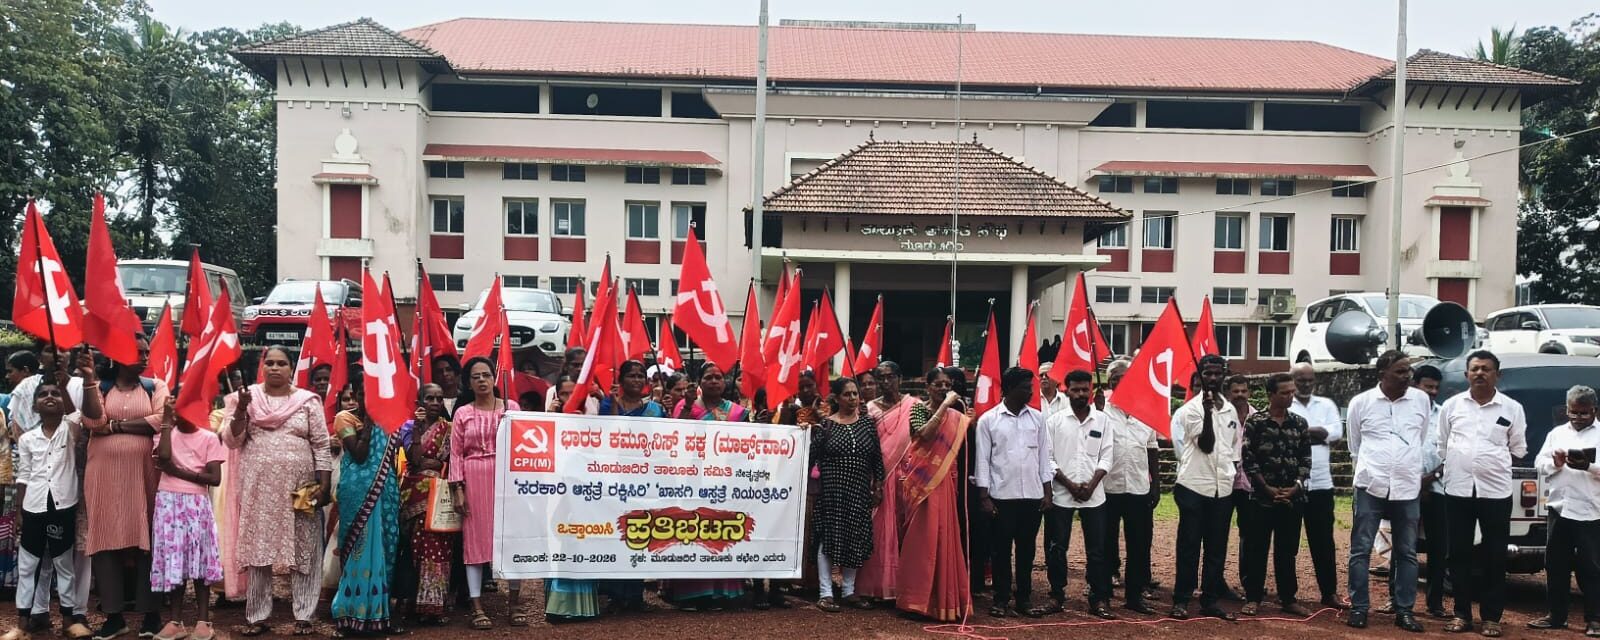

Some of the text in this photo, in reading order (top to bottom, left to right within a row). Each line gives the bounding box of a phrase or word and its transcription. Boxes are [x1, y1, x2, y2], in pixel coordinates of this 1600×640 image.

[561, 426, 603, 450] ಭಾರತ
[610, 427, 679, 458] ಕಮ್ಯೂನಿಸ್ಟ್
[685, 432, 707, 460] ಪಕ್ಷ
[514, 458, 551, 470] CPI(M)
[587, 460, 649, 474] ಮೂಡುಬಿದಿರೆ
[653, 464, 698, 477] ತಾಲೂಕು
[703, 465, 733, 478] ಸಮಿತಿ
[572, 481, 603, 502] ಆಸ್ಪತ್ರೆ
[698, 485, 727, 504] ಆಸ್ಪತ್ರೆ
[556, 510, 746, 550] ಒತ್ತಾಯಿಸಿ ಪ್ರತಿಭಟನೆ
[513, 553, 548, 563] ದಿನಾಂಕ:
[651, 553, 697, 563] ಮೂಡುಬಿದಿರೆ
[700, 553, 733, 563] ತಾಲೂಕು
[763, 553, 786, 563] ಎದುರು
